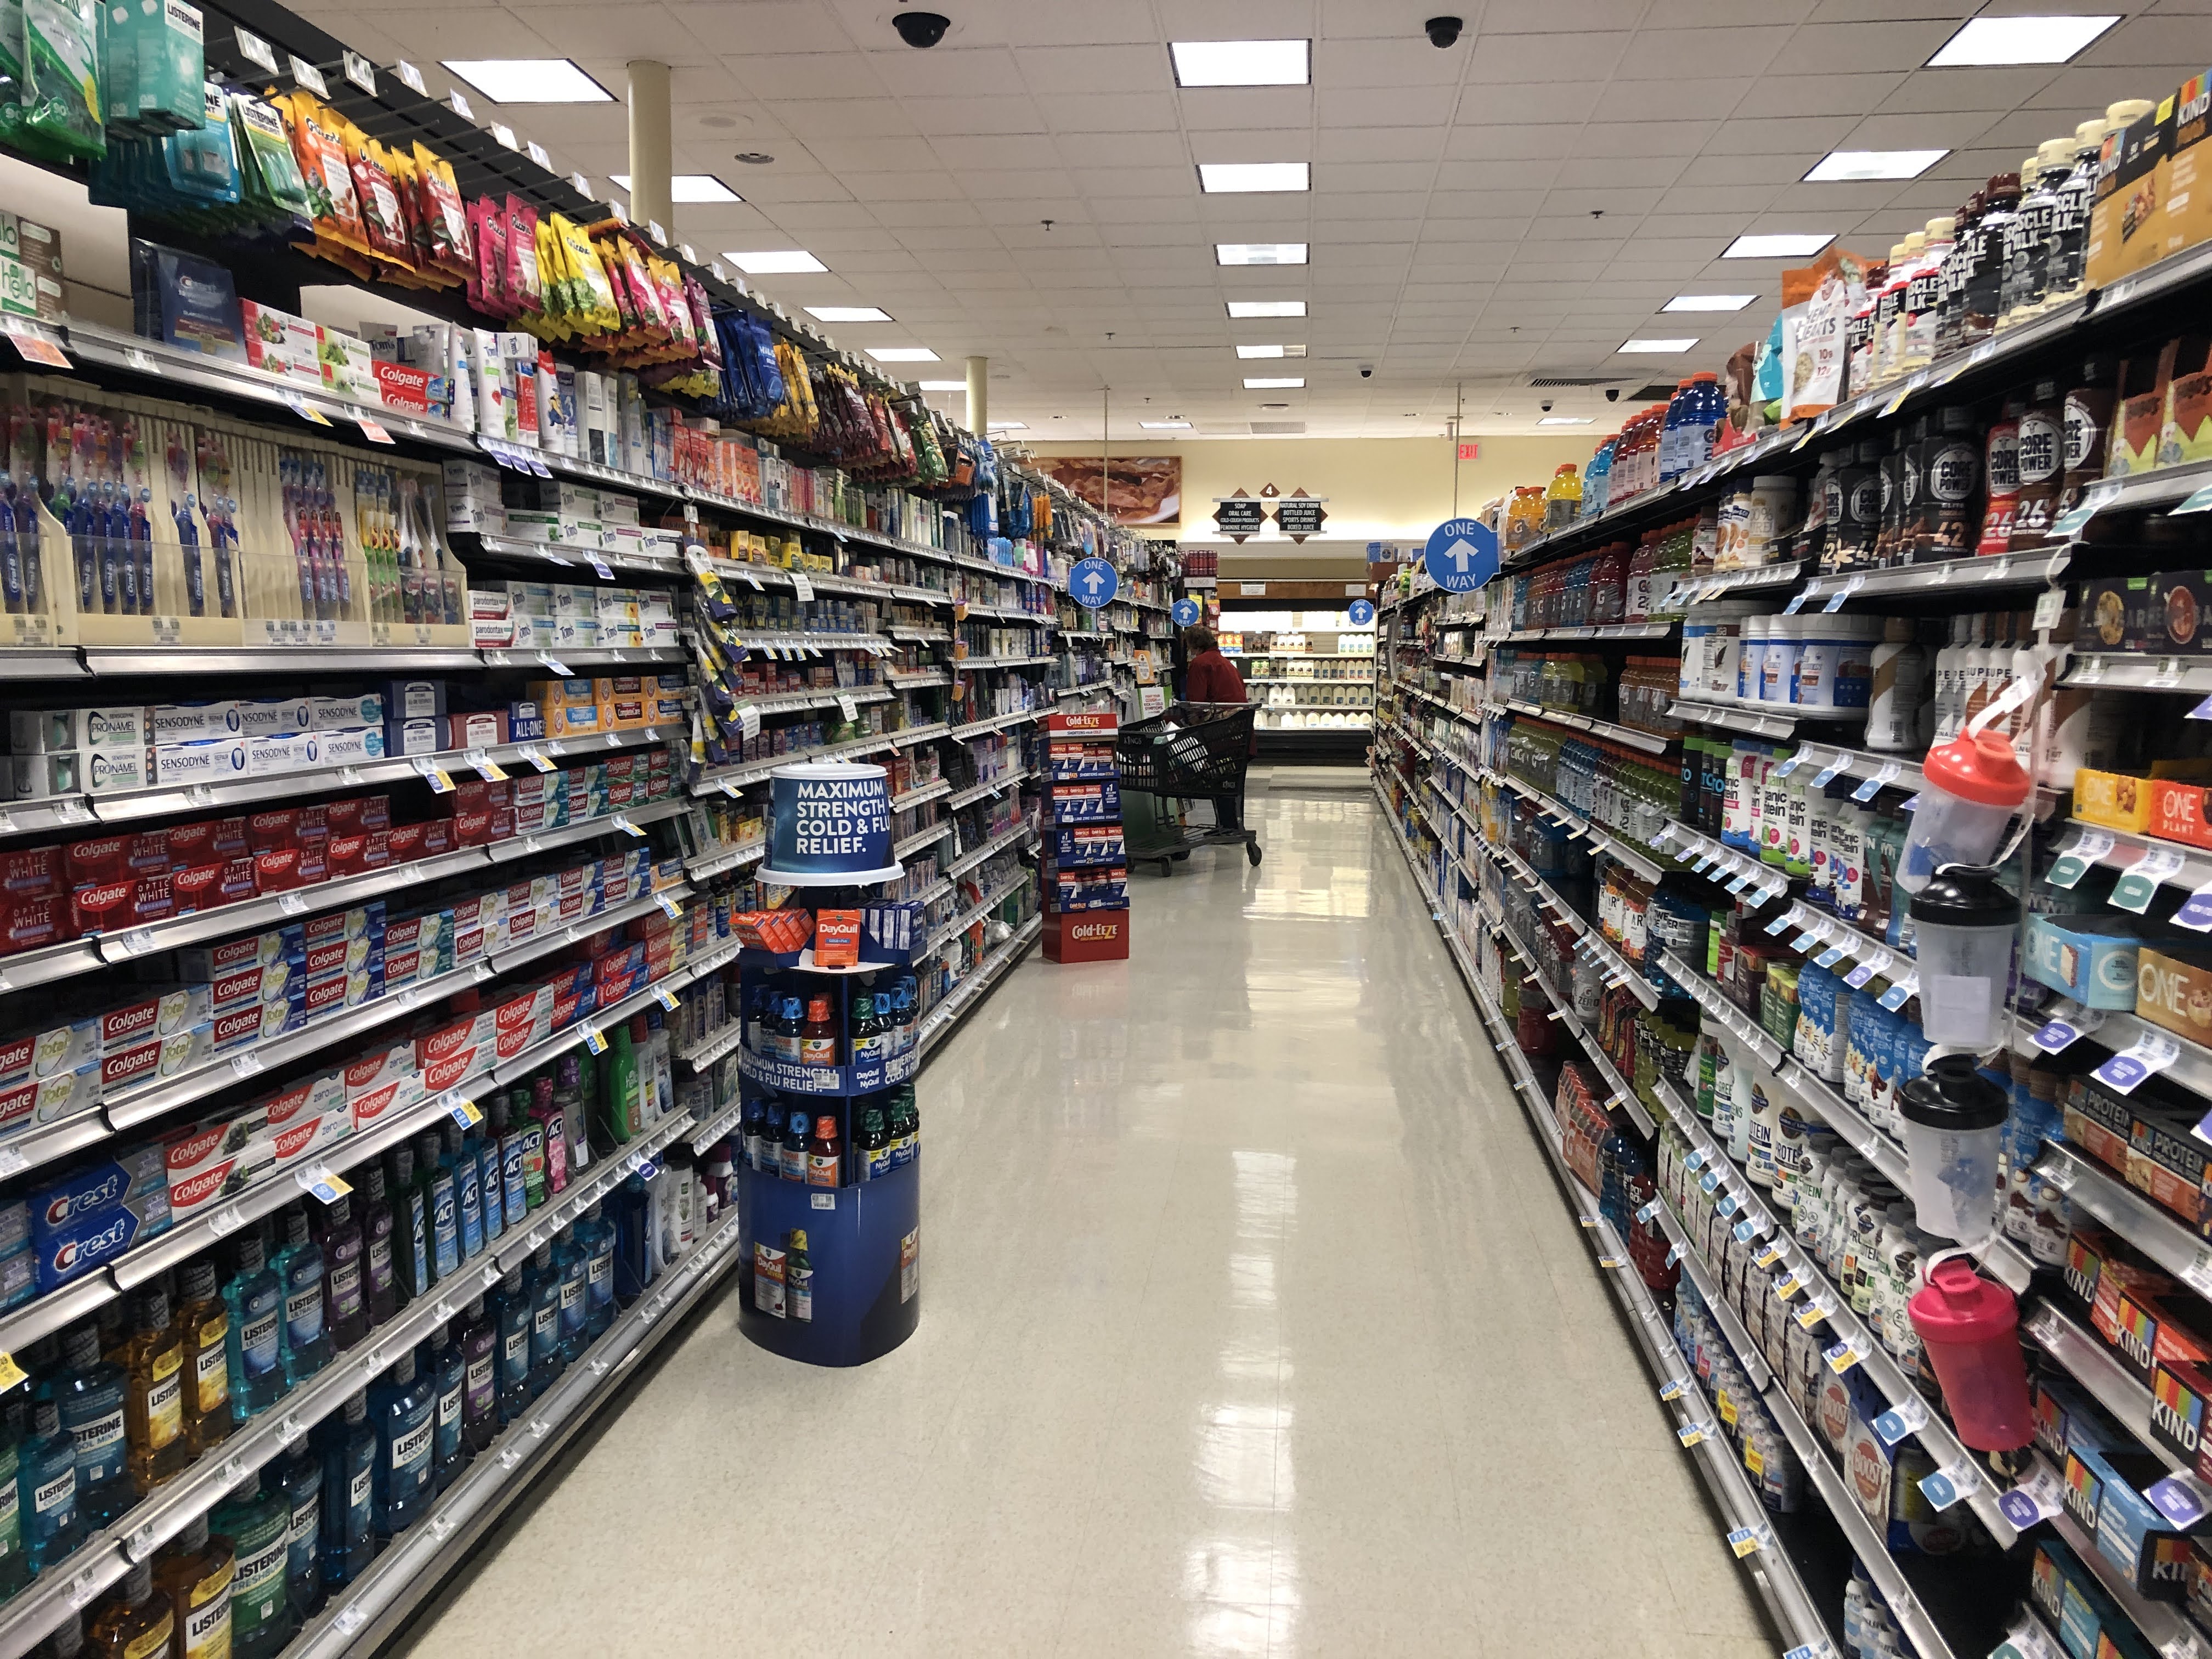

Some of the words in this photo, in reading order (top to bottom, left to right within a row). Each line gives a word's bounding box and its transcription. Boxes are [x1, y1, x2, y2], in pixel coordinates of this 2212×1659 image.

[167, 3, 201, 31] LISTERINE
[243, 109, 279, 128] LISTERINE
[2177, 92, 2210, 127] KIND
[2, 261, 34, 300] hello
[1909, 277, 1938, 295] SCLE
[370, 339, 395, 352] Tom's
[1819, 349, 1833, 359] 10g
[380, 366, 424, 387] Colgate
[1817, 366, 1831, 376] 12g
[1459, 444, 1479, 459] EXIT
[2021, 433, 2052, 455] CORE
[1941, 461, 1972, 478] CORE
[1266, 486, 1272, 495] 4
[2016, 499, 2046, 527] 26
[1444, 522, 1475, 537] ONE
[1987, 512, 2012, 539] 26
[1934, 522, 1965, 548] 42
[1085, 560, 1104, 571] ONE
[1446, 574, 1476, 589] WAY
[1081, 595, 1102, 605] WAY
[476, 625, 504, 636] parodontax
[560, 625, 574, 639] Tom's
[605, 627, 618, 639] Tom's
[318, 707, 357, 718] SENSODYNE
[1066, 716, 1099, 727] Cold-EEZE
[91, 721, 136, 733] PRONAMEL
[155, 716, 205, 729] SENSODYNE
[516, 718, 545, 738] ALL-ONE!
[328, 741, 362, 752] SENSODYNE
[1124, 736, 1142, 745] KINGS
[161, 755, 210, 769] SENSODYNE
[251, 746, 290, 760] SENSODYNE
[610, 787, 631, 800] Colgate
[798, 781, 883, 799] MAXIMUM
[521, 806, 543, 818] Colgate
[797, 799, 885, 817] STRENGTH
[2163, 791, 2197, 822] ONE
[796, 819, 851, 836] COLD
[857, 819, 868, 834] &
[872, 816, 890, 833] FLU
[2163, 822, 2194, 833] PLANT
[330, 839, 359, 855] Colgate
[796, 837, 866, 854] RELIEF.
[224, 865, 251, 874] OPTIC
[261, 853, 292, 870] Colgate
[178, 868, 216, 886] Colgate
[224, 871, 251, 883] WHITE
[81, 886, 126, 905] Colgate
[138, 882, 170, 894] OPTIC
[138, 888, 170, 902] WHITE
[511, 915, 534, 930] Colgate
[820, 923, 857, 935] DayQuil
[913, 918, 923, 927] NyQuil
[1072, 924, 1119, 939] Cold-EEZE
[387, 923, 419, 941] Colgate
[388, 955, 418, 974] Colgate
[218, 976, 257, 996] Colgate
[309, 983, 343, 1002] Colgate
[605, 979, 631, 996] Colgate
[2140, 963, 2190, 1014] ONE
[1578, 996, 1599, 1006] ZERO
[108, 1008, 154, 1032] Colgate
[499, 1002, 531, 1024] Colgate
[218, 1014, 258, 1035] Colgate
[39, 1039, 66, 1057] Total
[428, 1029, 467, 1054] Colgate
[499, 1031, 529, 1051] Colgate
[742, 1049, 775, 1071] MAXIMUM
[803, 1051, 830, 1060] DayQuil
[861, 1049, 880, 1058] NyQuil
[107, 1051, 156, 1076] Colgate
[429, 1058, 467, 1082] Colgate
[742, 1065, 757, 1079] COLD
[759, 1073, 764, 1081] &
[765, 1075, 780, 1086] FLU
[856, 1069, 879, 1079] DayQuil
[860, 1078, 879, 1088] NyQuil
[885, 1069, 904, 1085] COLD
[905, 1067, 910, 1076] &
[399, 1086, 414, 1097] zero
[0, 1094, 31, 1119] gate
[2087, 1091, 2130, 1126] PROTEIN
[322, 1121, 337, 1135] zero
[550, 1120, 562, 1136] ACT
[1750, 1120, 1771, 1145] OTEIN
[171, 1134, 218, 1163] Colgate
[275, 1128, 313, 1152] Colgate
[523, 1135, 541, 1151] ACT
[2154, 1133, 2203, 1169] PROTEIN
[506, 1154, 522, 1175] ACT
[809, 1168, 831, 1177] DayQuil
[174, 1171, 223, 1198] Colgate
[487, 1168, 498, 1189] AC
[47, 1173, 117, 1223] Crest
[464, 1183, 478, 1202] ACT
[436, 1201, 453, 1223] ACT
[55, 1220, 125, 1271] Crest
[758, 1257, 781, 1273] DayQuil
[768, 1270, 783, 1279] SEVERE
[788, 1276, 808, 1287] NyQuil
[2063, 1266, 2095, 1302] KIND
[2117, 1324, 2151, 1369] KIND
[1824, 1396, 1848, 1425] BOOST
[74, 1417, 121, 1443] STERINE
[2153, 1398, 2197, 1451] KIND
[1854, 1455, 1882, 1484] BOOST
[2066, 1485, 2096, 1528] KIND
[233, 1542, 286, 1579] LISTERINE
[2032, 1567, 2059, 1616] KIND
